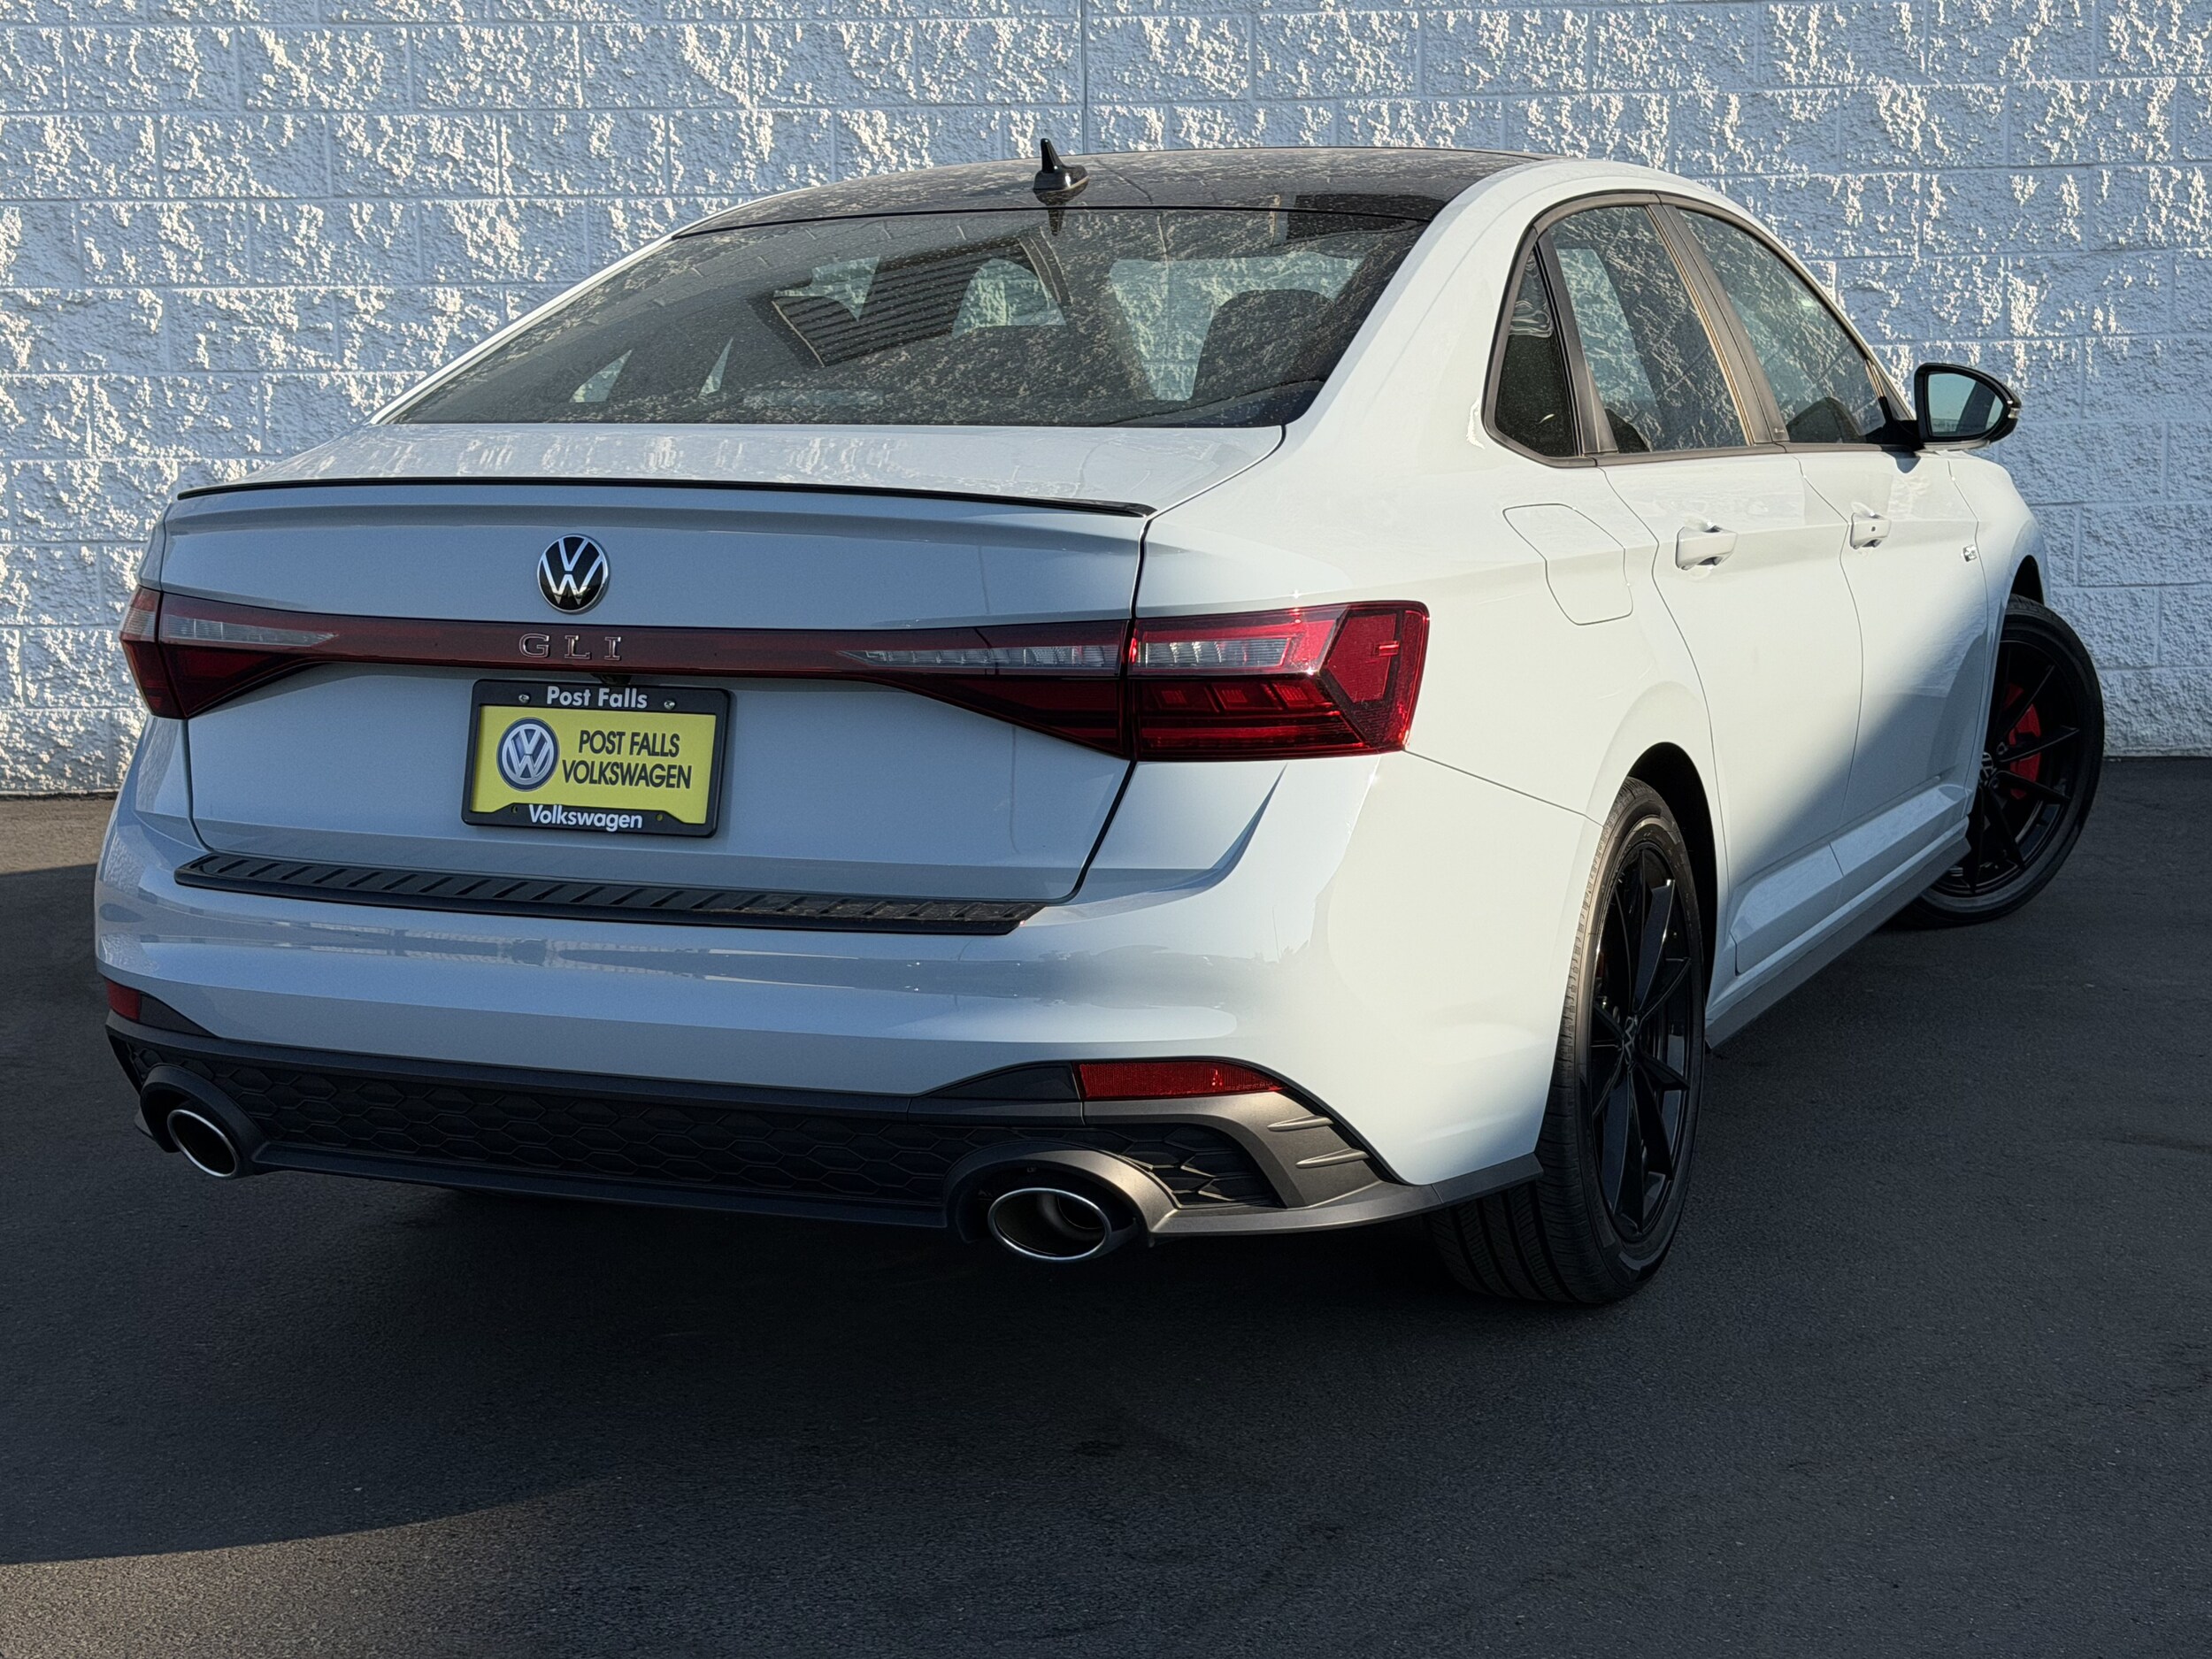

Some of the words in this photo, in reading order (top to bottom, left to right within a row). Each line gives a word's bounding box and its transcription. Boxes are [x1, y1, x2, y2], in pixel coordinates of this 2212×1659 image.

[538, 534, 609, 613] VW
[518, 633, 622, 660] GLI
[546, 686, 591, 706] Post
[598, 688, 648, 709] Falls
[579, 730, 626, 754] POST
[630, 733, 680, 757] FALLS
[562, 760, 692, 788] VOLKSWAGEN
[529, 804, 642, 832] Volkswagen
